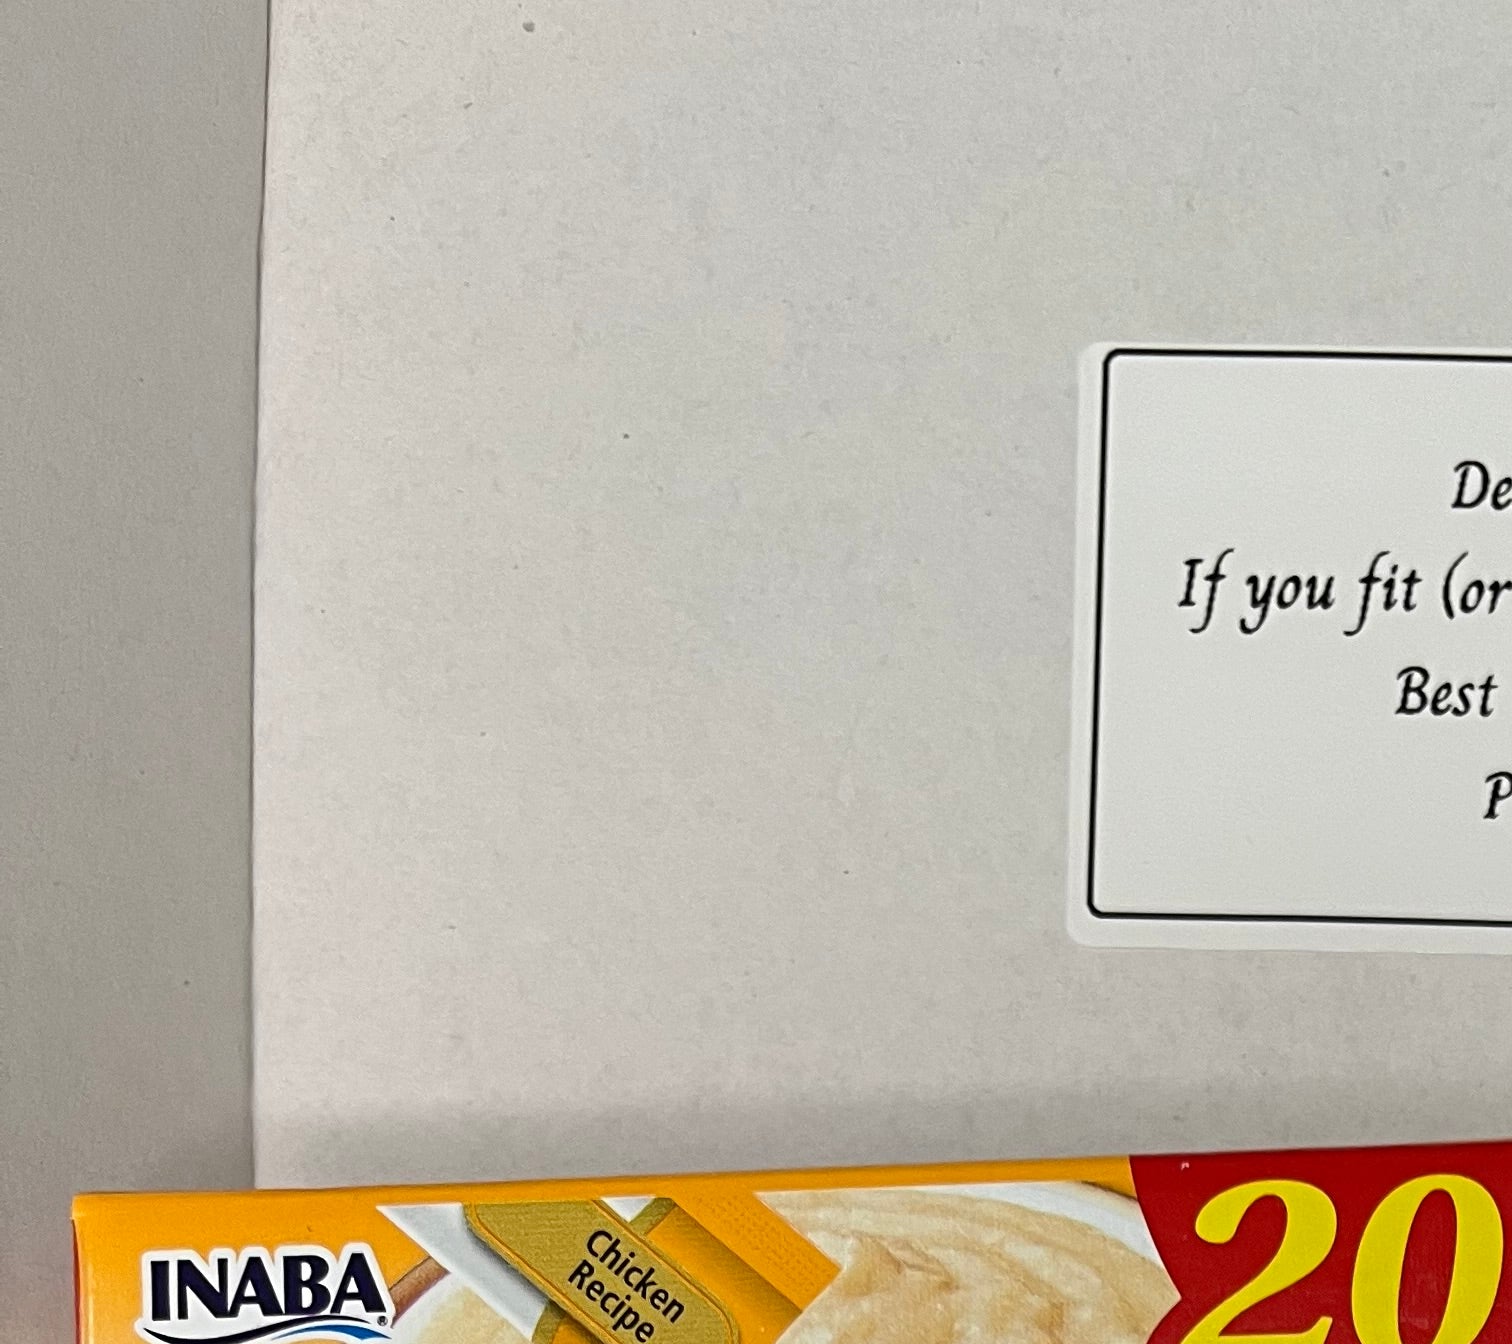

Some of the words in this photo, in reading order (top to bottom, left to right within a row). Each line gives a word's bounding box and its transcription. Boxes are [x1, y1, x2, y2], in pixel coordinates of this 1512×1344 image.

[1179, 547, 1235, 635] If
[1240, 568, 1335, 634] you
[1344, 550, 1422, 638] fit
[1395, 665, 1496, 719] Best
[149, 1252, 388, 1322] INABA
[585, 1227, 686, 1325] Chicken
